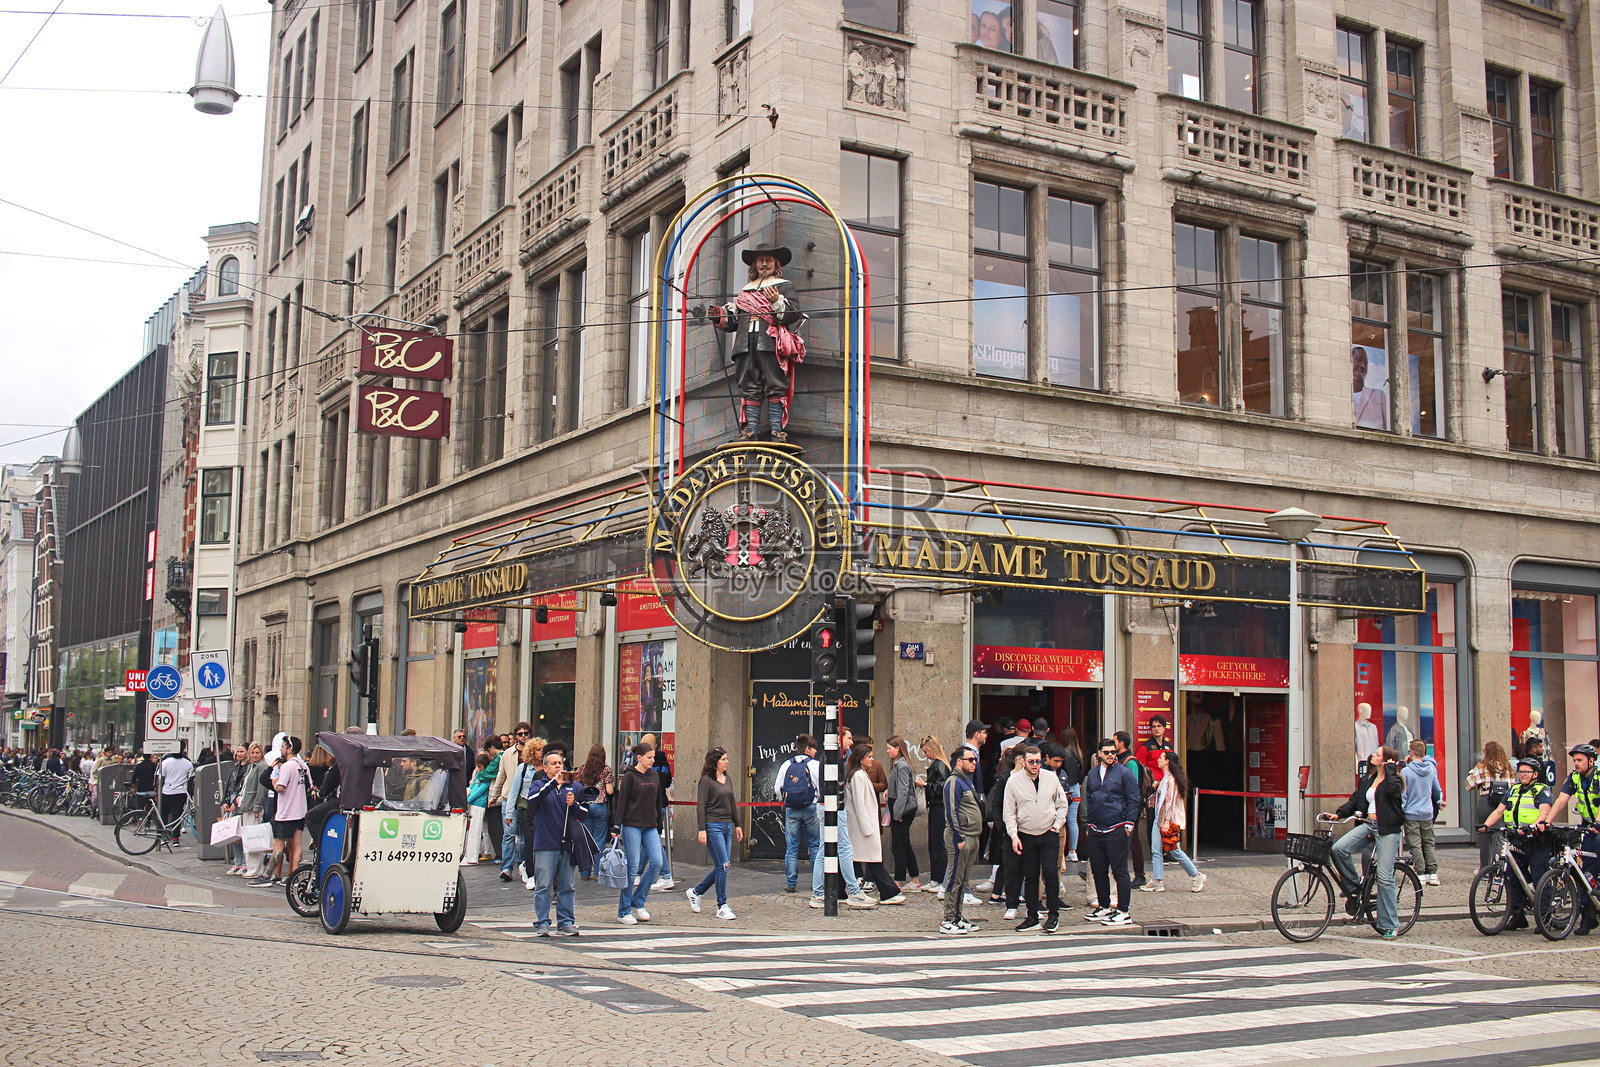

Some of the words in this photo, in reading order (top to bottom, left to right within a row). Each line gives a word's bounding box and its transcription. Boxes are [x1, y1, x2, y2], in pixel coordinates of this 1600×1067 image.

[368, 332, 442, 372] P&C
[365, 391, 439, 431] P&C
[655, 454, 748, 552] MADAME
[756, 453, 838, 549] TUSSAUD
[876, 533, 1048, 579] MADAME
[1064, 549, 1217, 591] TUSSAUD
[417, 576, 467, 611] MADAME
[469, 563, 528, 600] TUSSAUD
[994, 652, 1041, 664] DISCOVER
[1049, 655, 1083, 665] WORLD
[1002, 662, 1015, 671] OF
[1016, 663, 1054, 673] FAMOUS
[1055, 665, 1075, 674] FUN
[1216, 661, 1234, 671] GET
[1234, 662, 1256, 672] YOUR
[128, 672, 145, 681] UNI
[1207, 670, 1241, 680] TICKETS
[1242, 671, 1266, 681] HERE!
[128, 680, 146, 690] QLO
[762, 692, 811, 708] Madame
[807, 693, 859, 708] Tuuds
[155, 716, 171, 726] 30
[757, 745, 778, 762] Try
[364, 851, 383, 862] +31
[387, 851, 453, 863] 649919930
